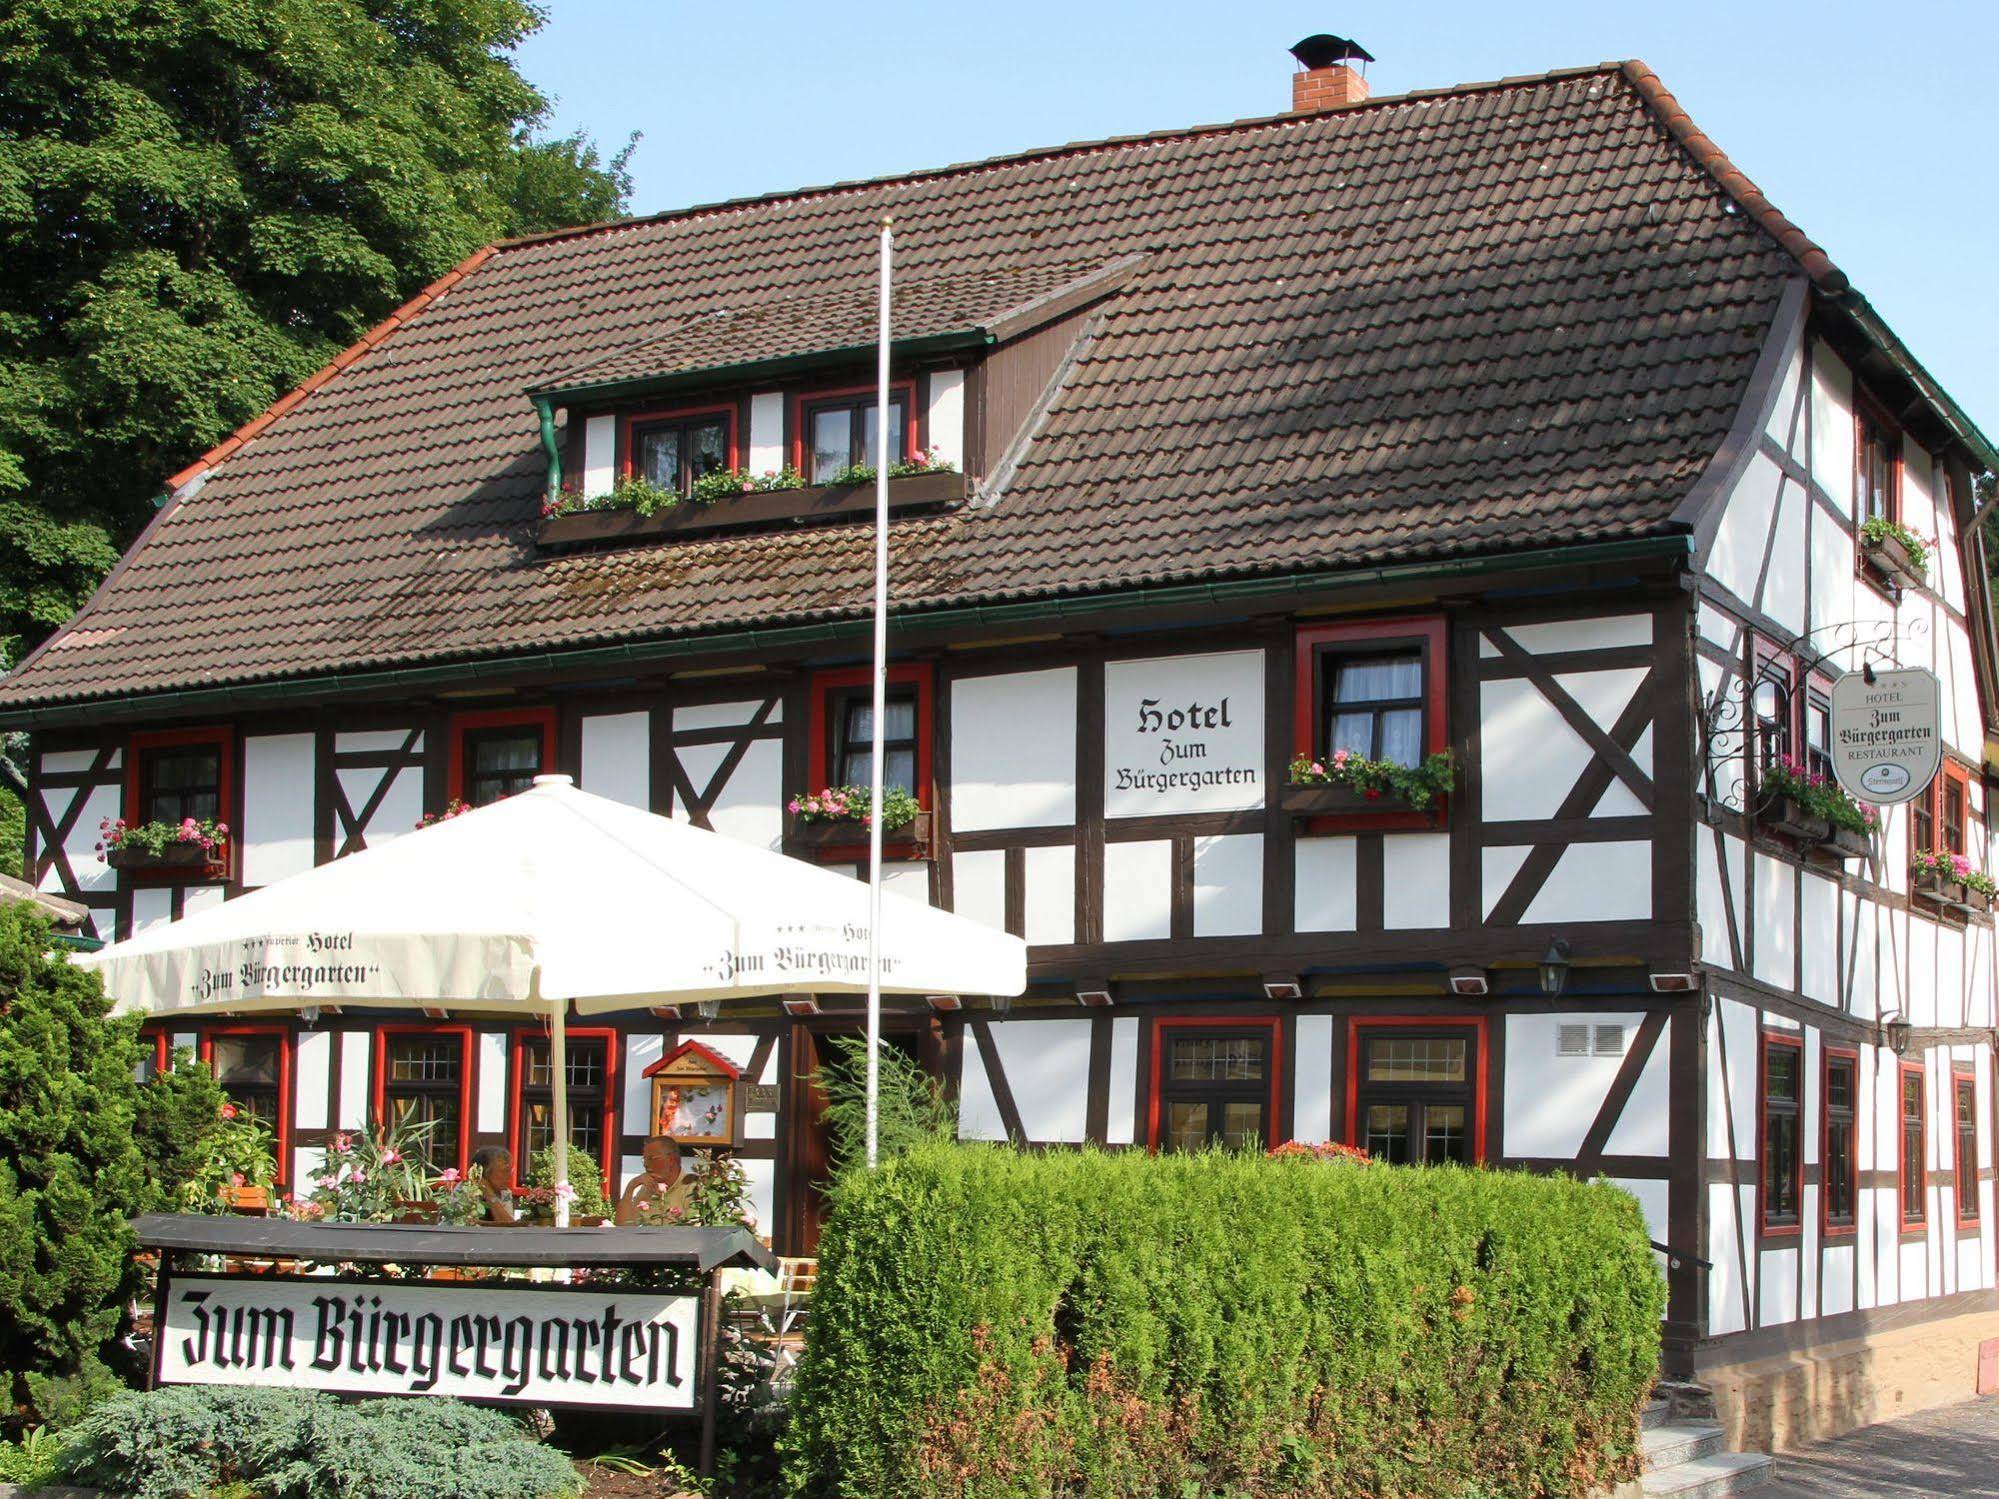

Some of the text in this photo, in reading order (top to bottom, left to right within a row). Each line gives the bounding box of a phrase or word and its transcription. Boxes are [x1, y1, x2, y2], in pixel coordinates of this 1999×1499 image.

[1865, 692, 1903, 704] HOTEL
[1136, 696, 1233, 733] Hotel
[1869, 709, 1901, 728] Zum
[1839, 725, 1931, 746] Bürgergarten
[1159, 738, 1207, 766] Zum
[1847, 746, 1924, 760] RESTAURANT
[1115, 766, 1256, 793] Bürgergarten
[306, 930, 353, 953] Hotel
[842, 923, 871, 942] Hot
[182, 1290, 684, 1396] Zum Bürgergarten
